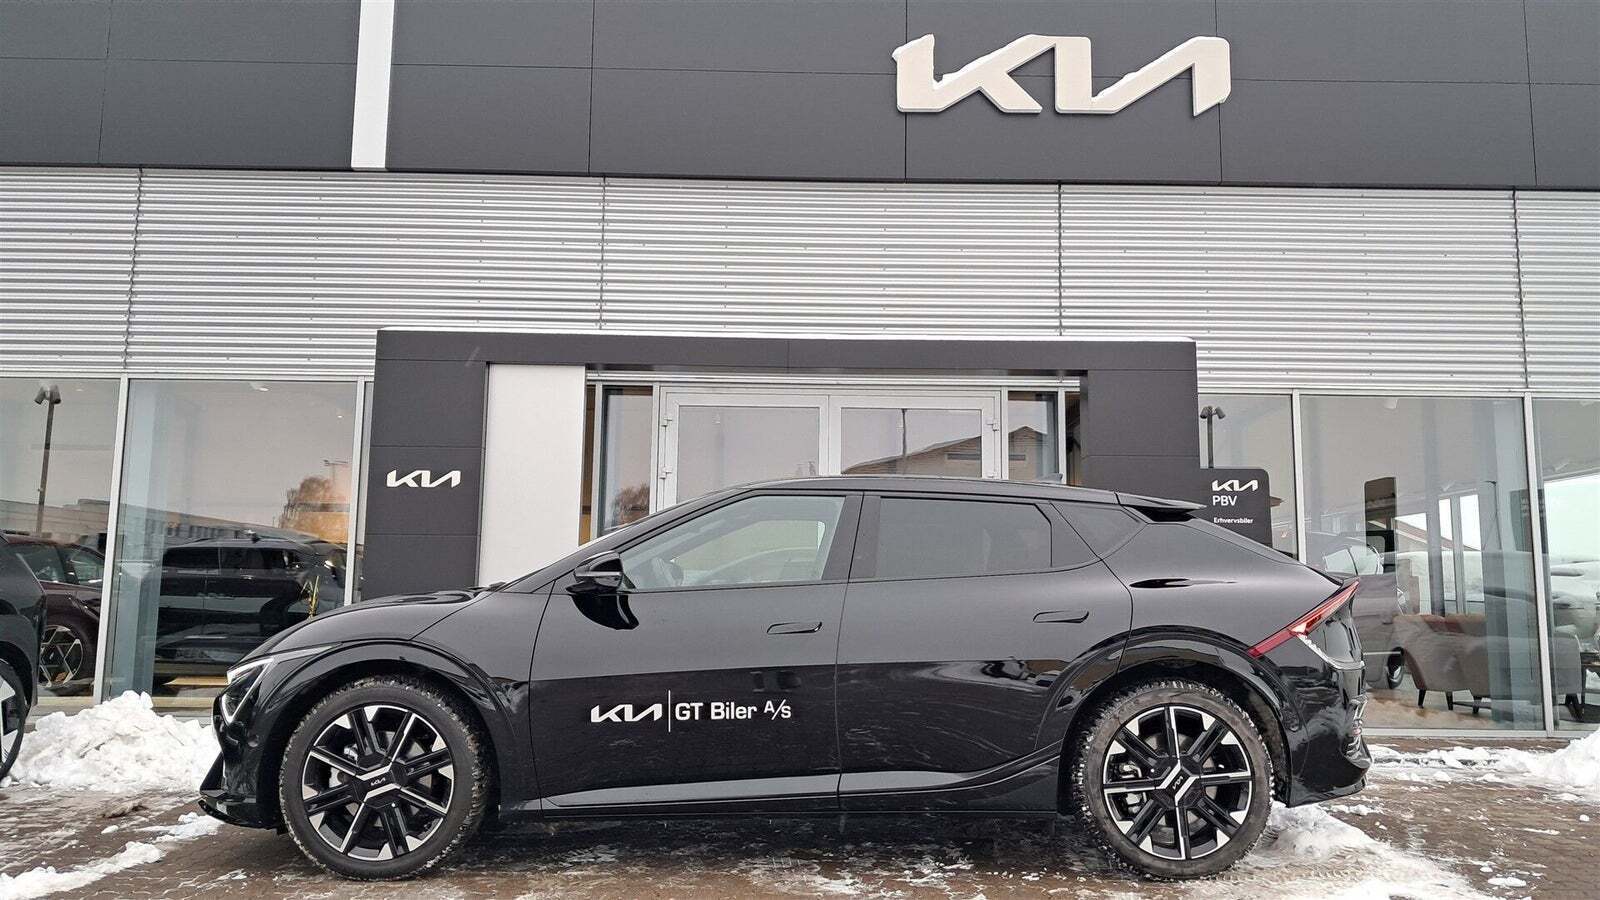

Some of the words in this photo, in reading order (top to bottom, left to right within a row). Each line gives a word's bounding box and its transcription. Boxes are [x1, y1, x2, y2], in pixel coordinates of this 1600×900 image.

[892, 34, 1231, 116] KIA
[386, 469, 461, 488] KIA
[1211, 479, 1258, 492] KIA
[1212, 495, 1238, 506] PBV
[590, 703, 663, 723] KIA
[675, 702, 704, 721] GT
[710, 701, 758, 721] Biler
